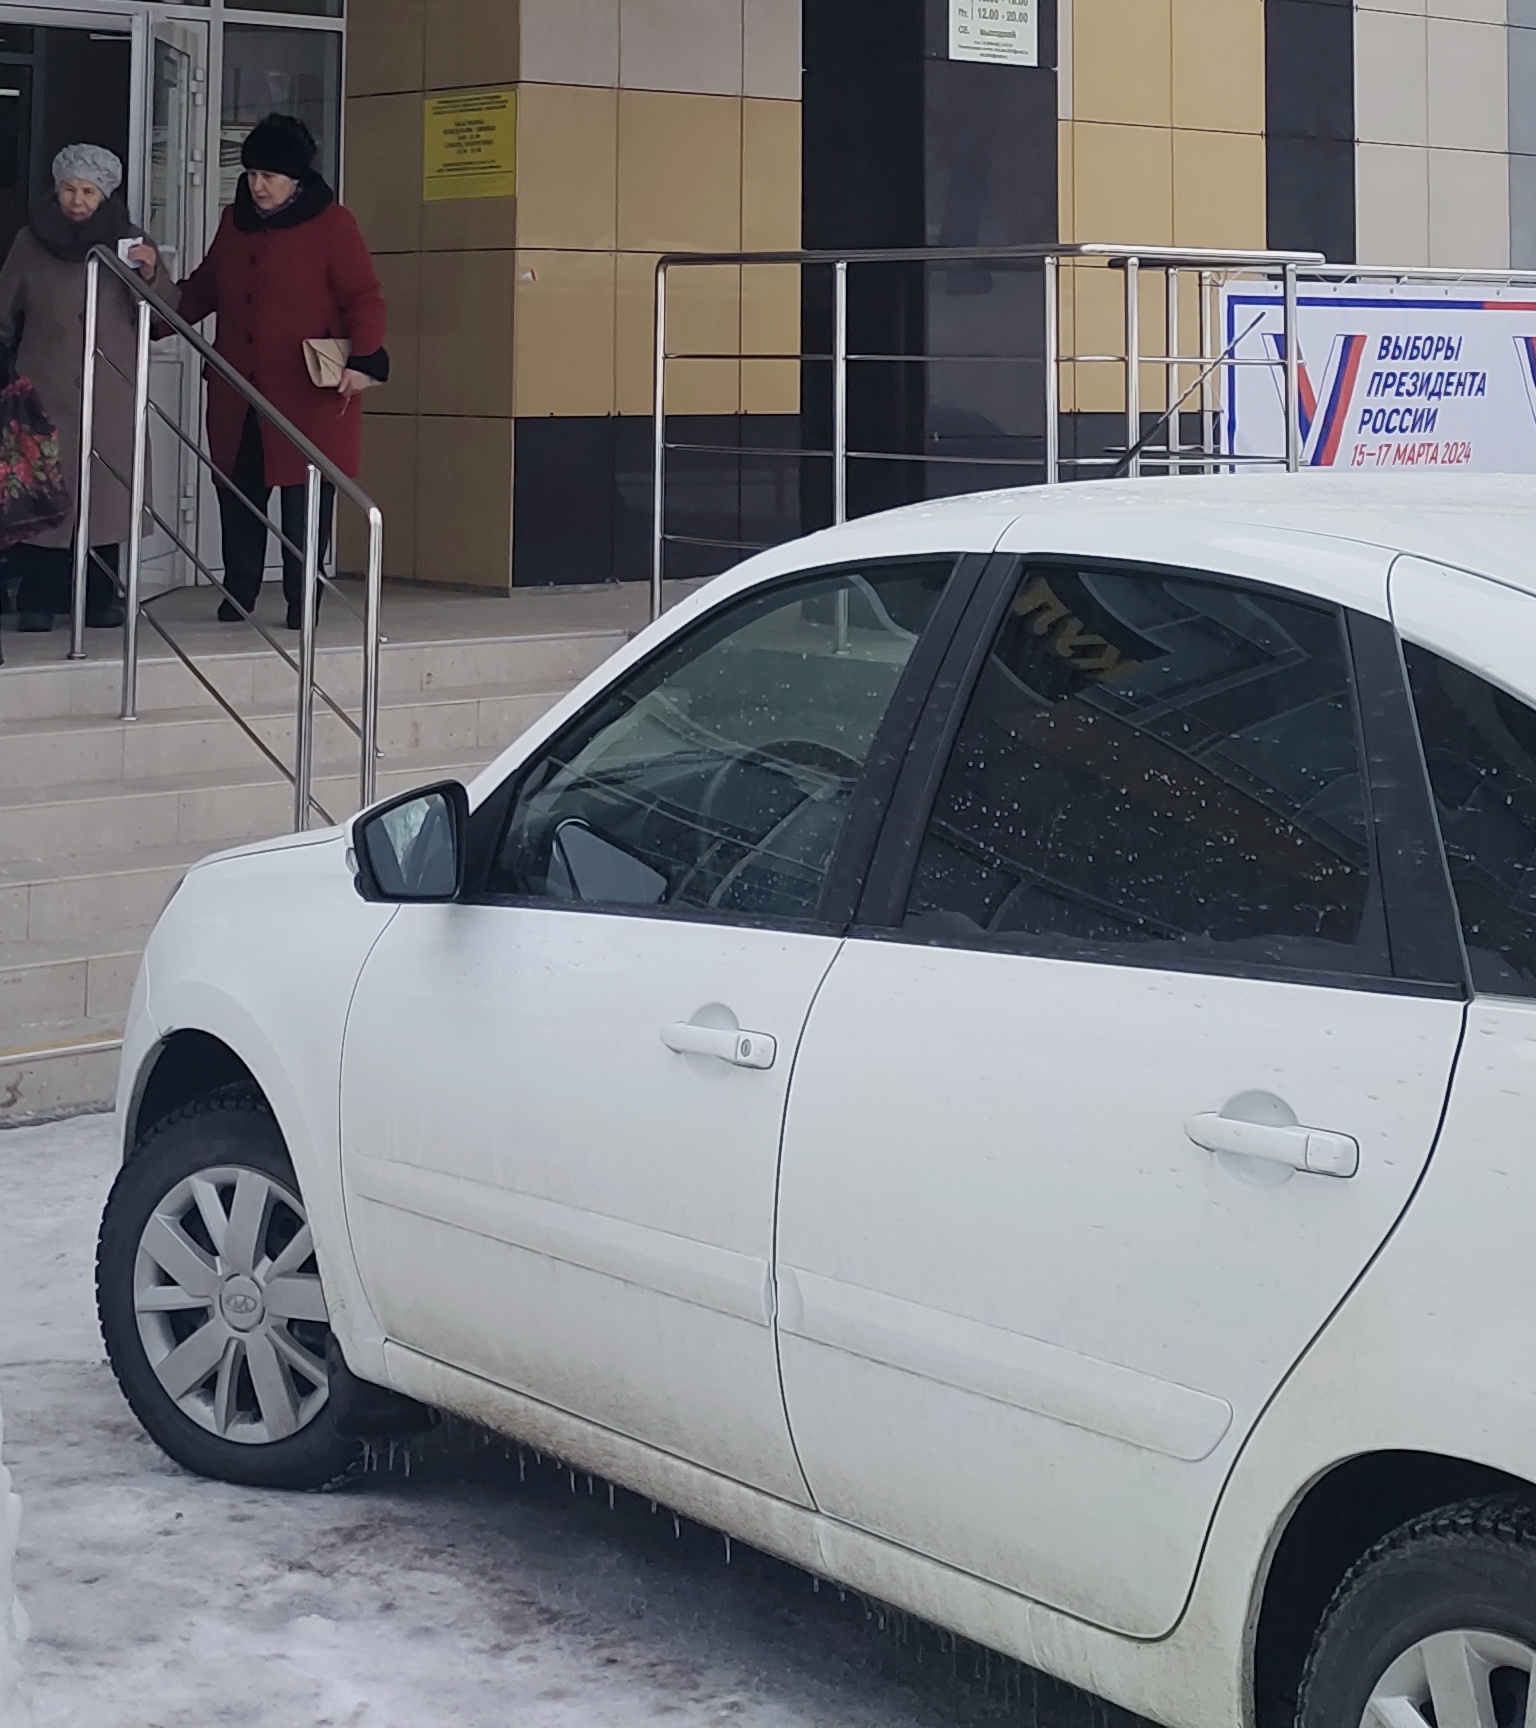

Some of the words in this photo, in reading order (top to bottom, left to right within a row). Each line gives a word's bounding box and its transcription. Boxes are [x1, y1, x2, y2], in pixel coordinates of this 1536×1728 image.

[1377, 335, 1462, 361] ВЫБОРЫ
[1366, 371, 1487, 401] ПРЕЗИДЕНТА
[1357, 407, 1439, 434] РОССИИ
[1392, 442, 1439, 466] МАРТА
[1440, 441, 1471, 464] 2024
